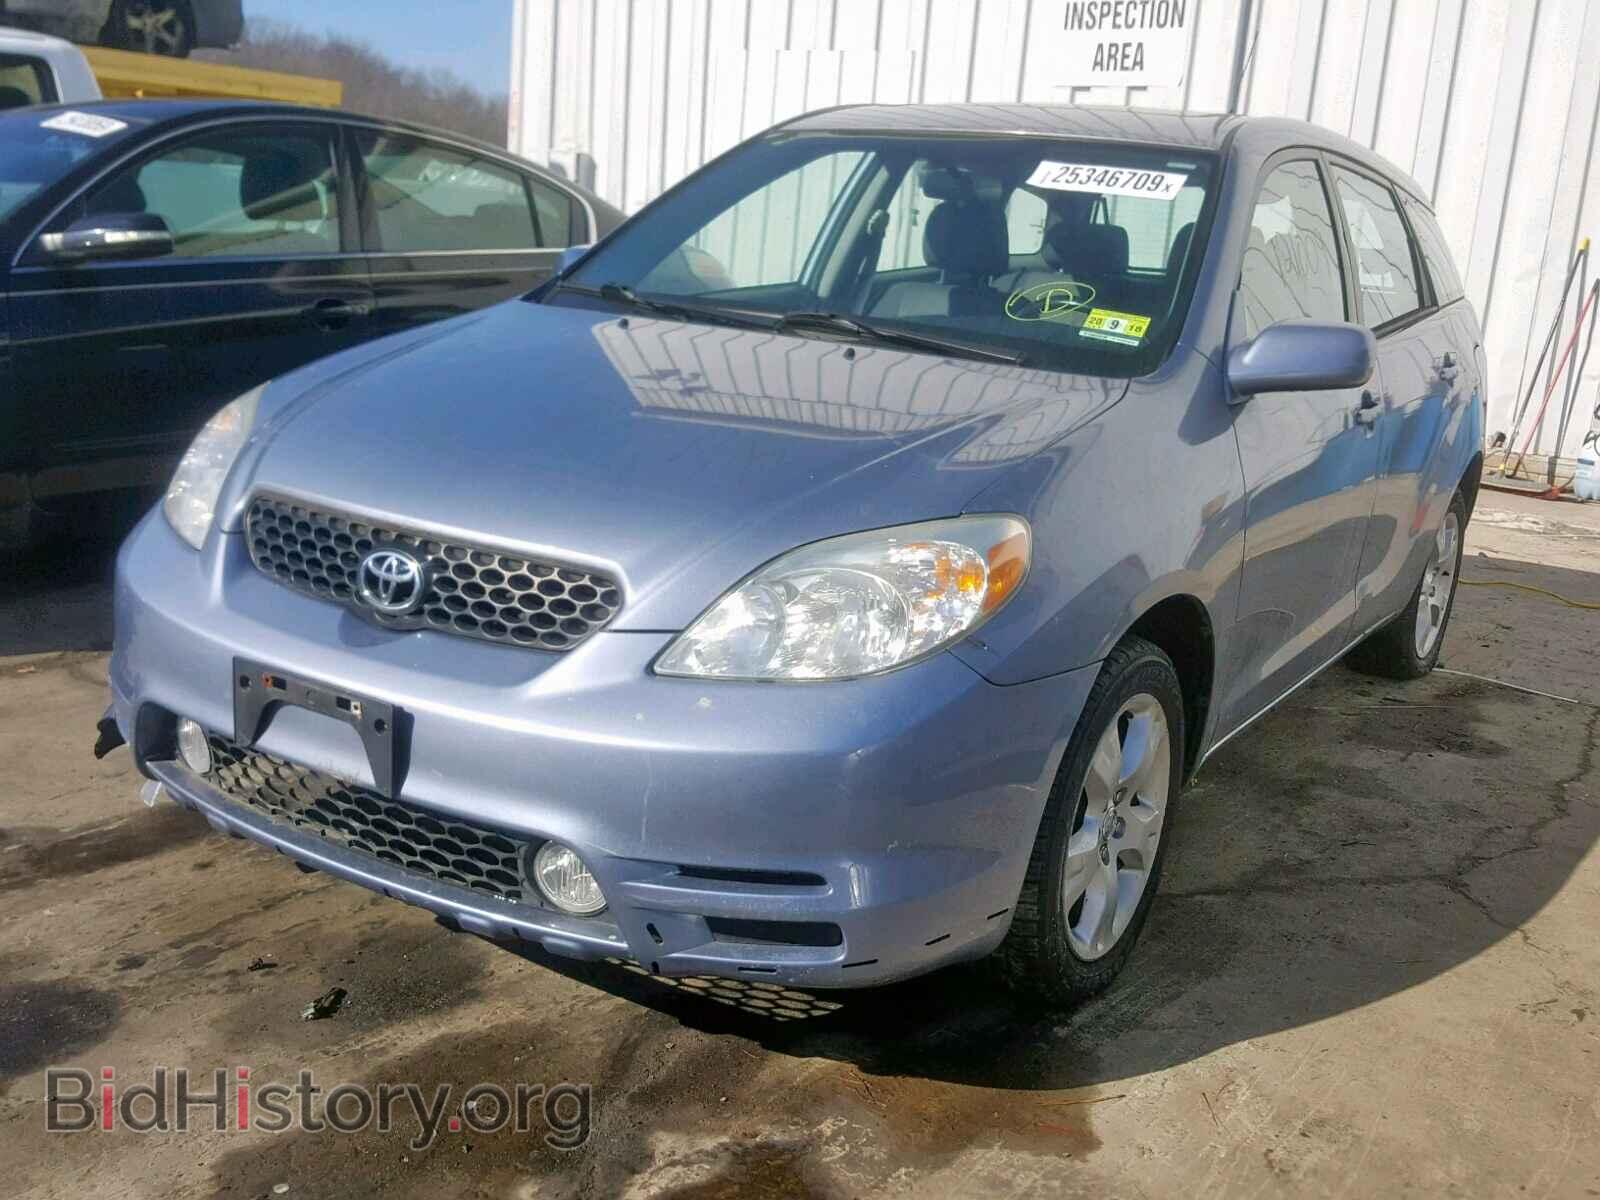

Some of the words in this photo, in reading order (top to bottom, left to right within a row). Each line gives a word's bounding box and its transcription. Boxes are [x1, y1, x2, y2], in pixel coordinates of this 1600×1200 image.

[1064, 0, 1186, 30] INSPECTION
[1092, 42, 1144, 72] AREA
[1109, 319, 1119, 330] 9
